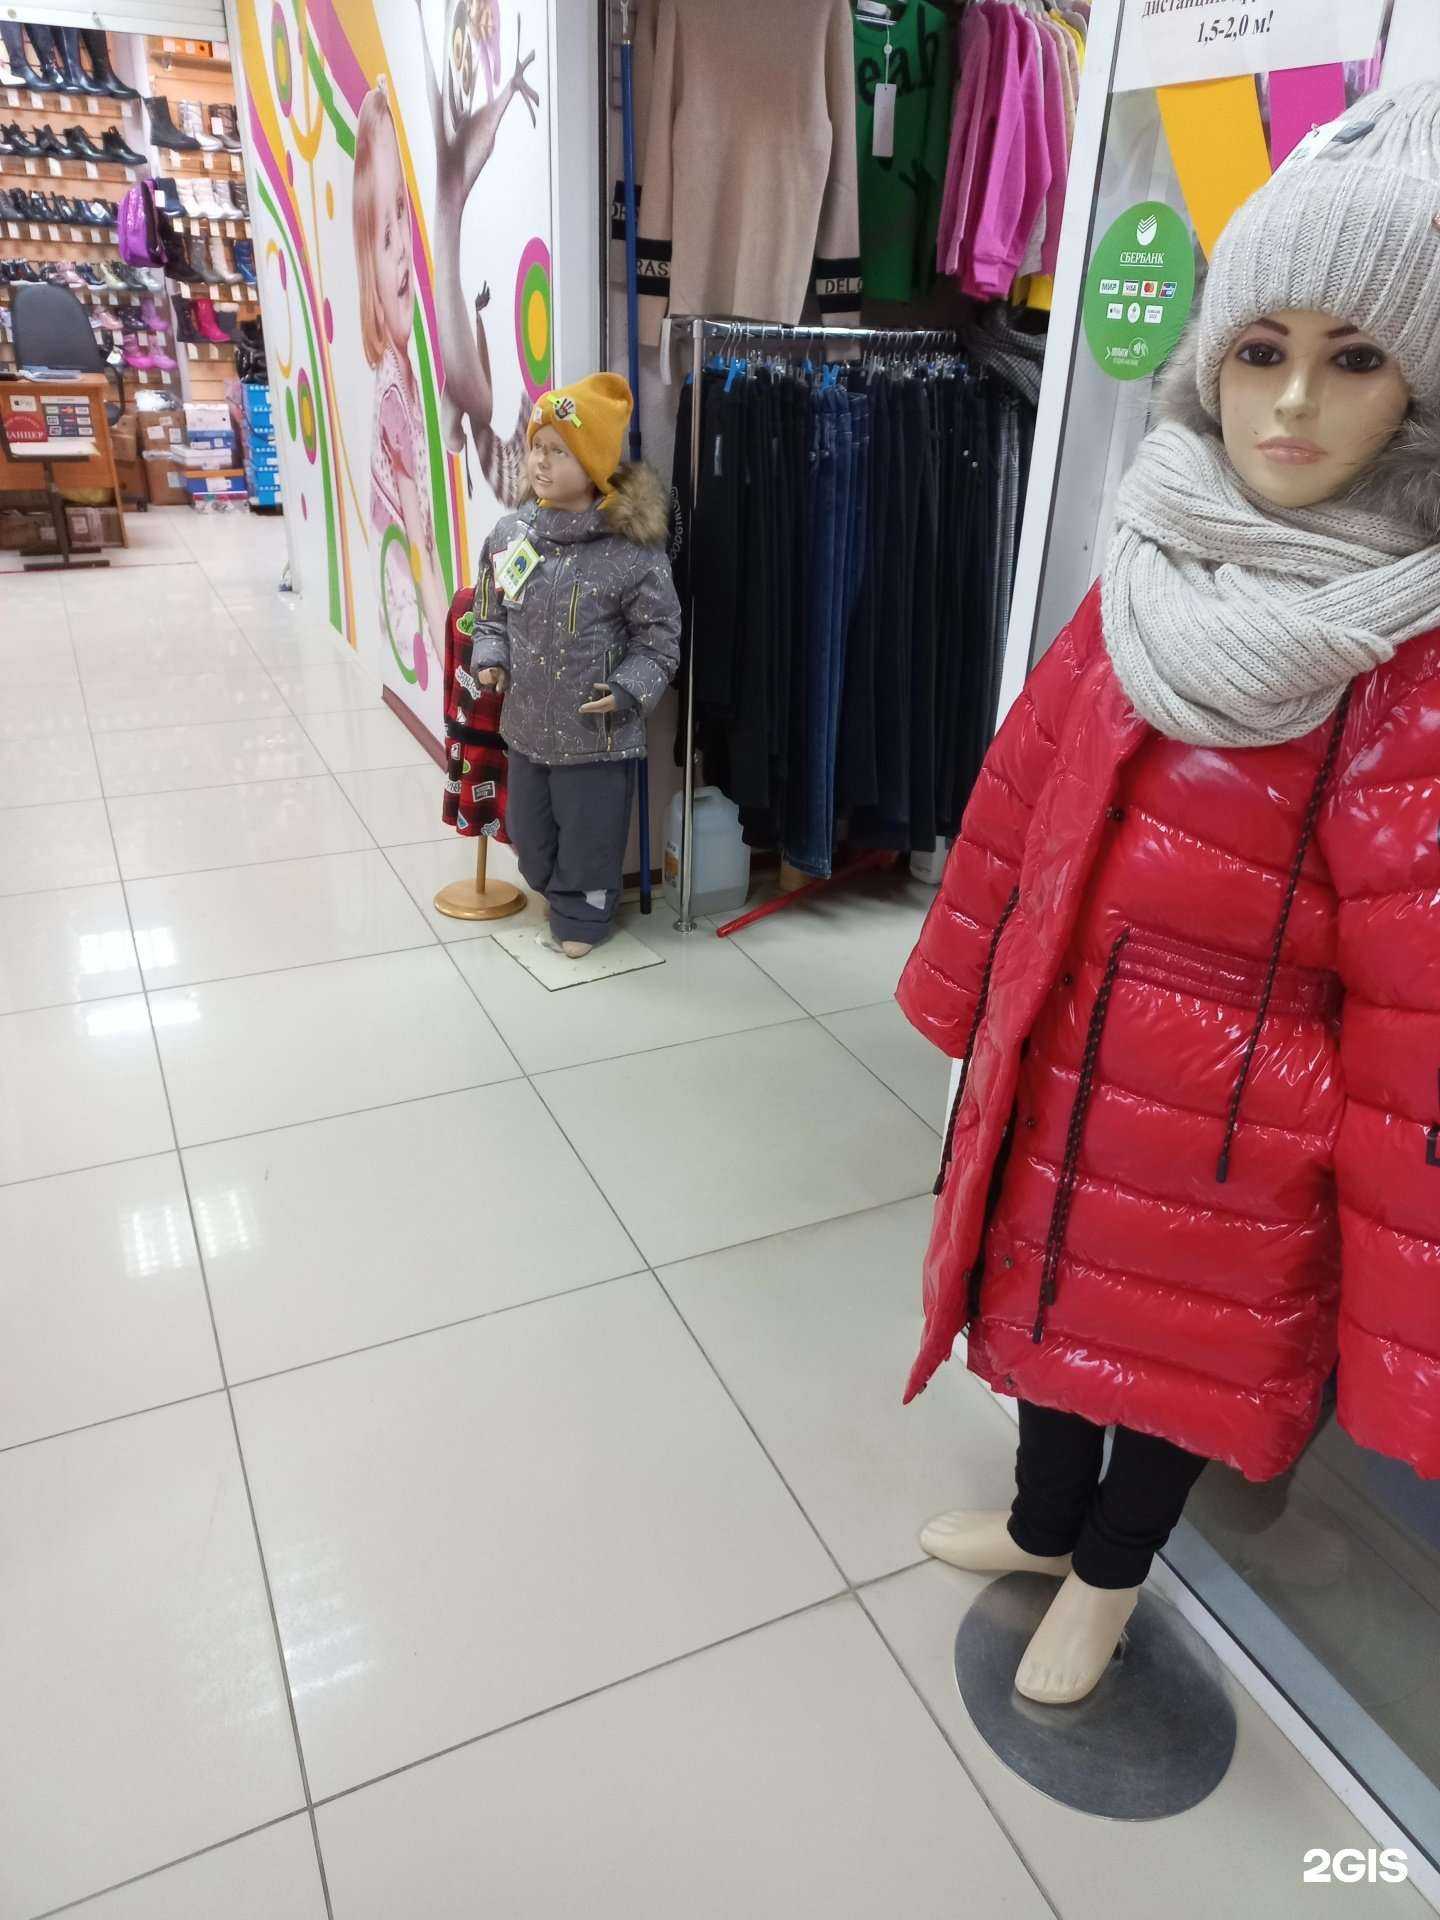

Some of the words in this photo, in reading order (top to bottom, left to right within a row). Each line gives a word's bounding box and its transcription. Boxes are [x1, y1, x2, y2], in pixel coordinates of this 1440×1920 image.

[1197, 14, 1249, 44] 1,5-2,0
[1253, 9, 1274, 34] м!
[1120, 251, 1165, 264] СБЕРБАНК
